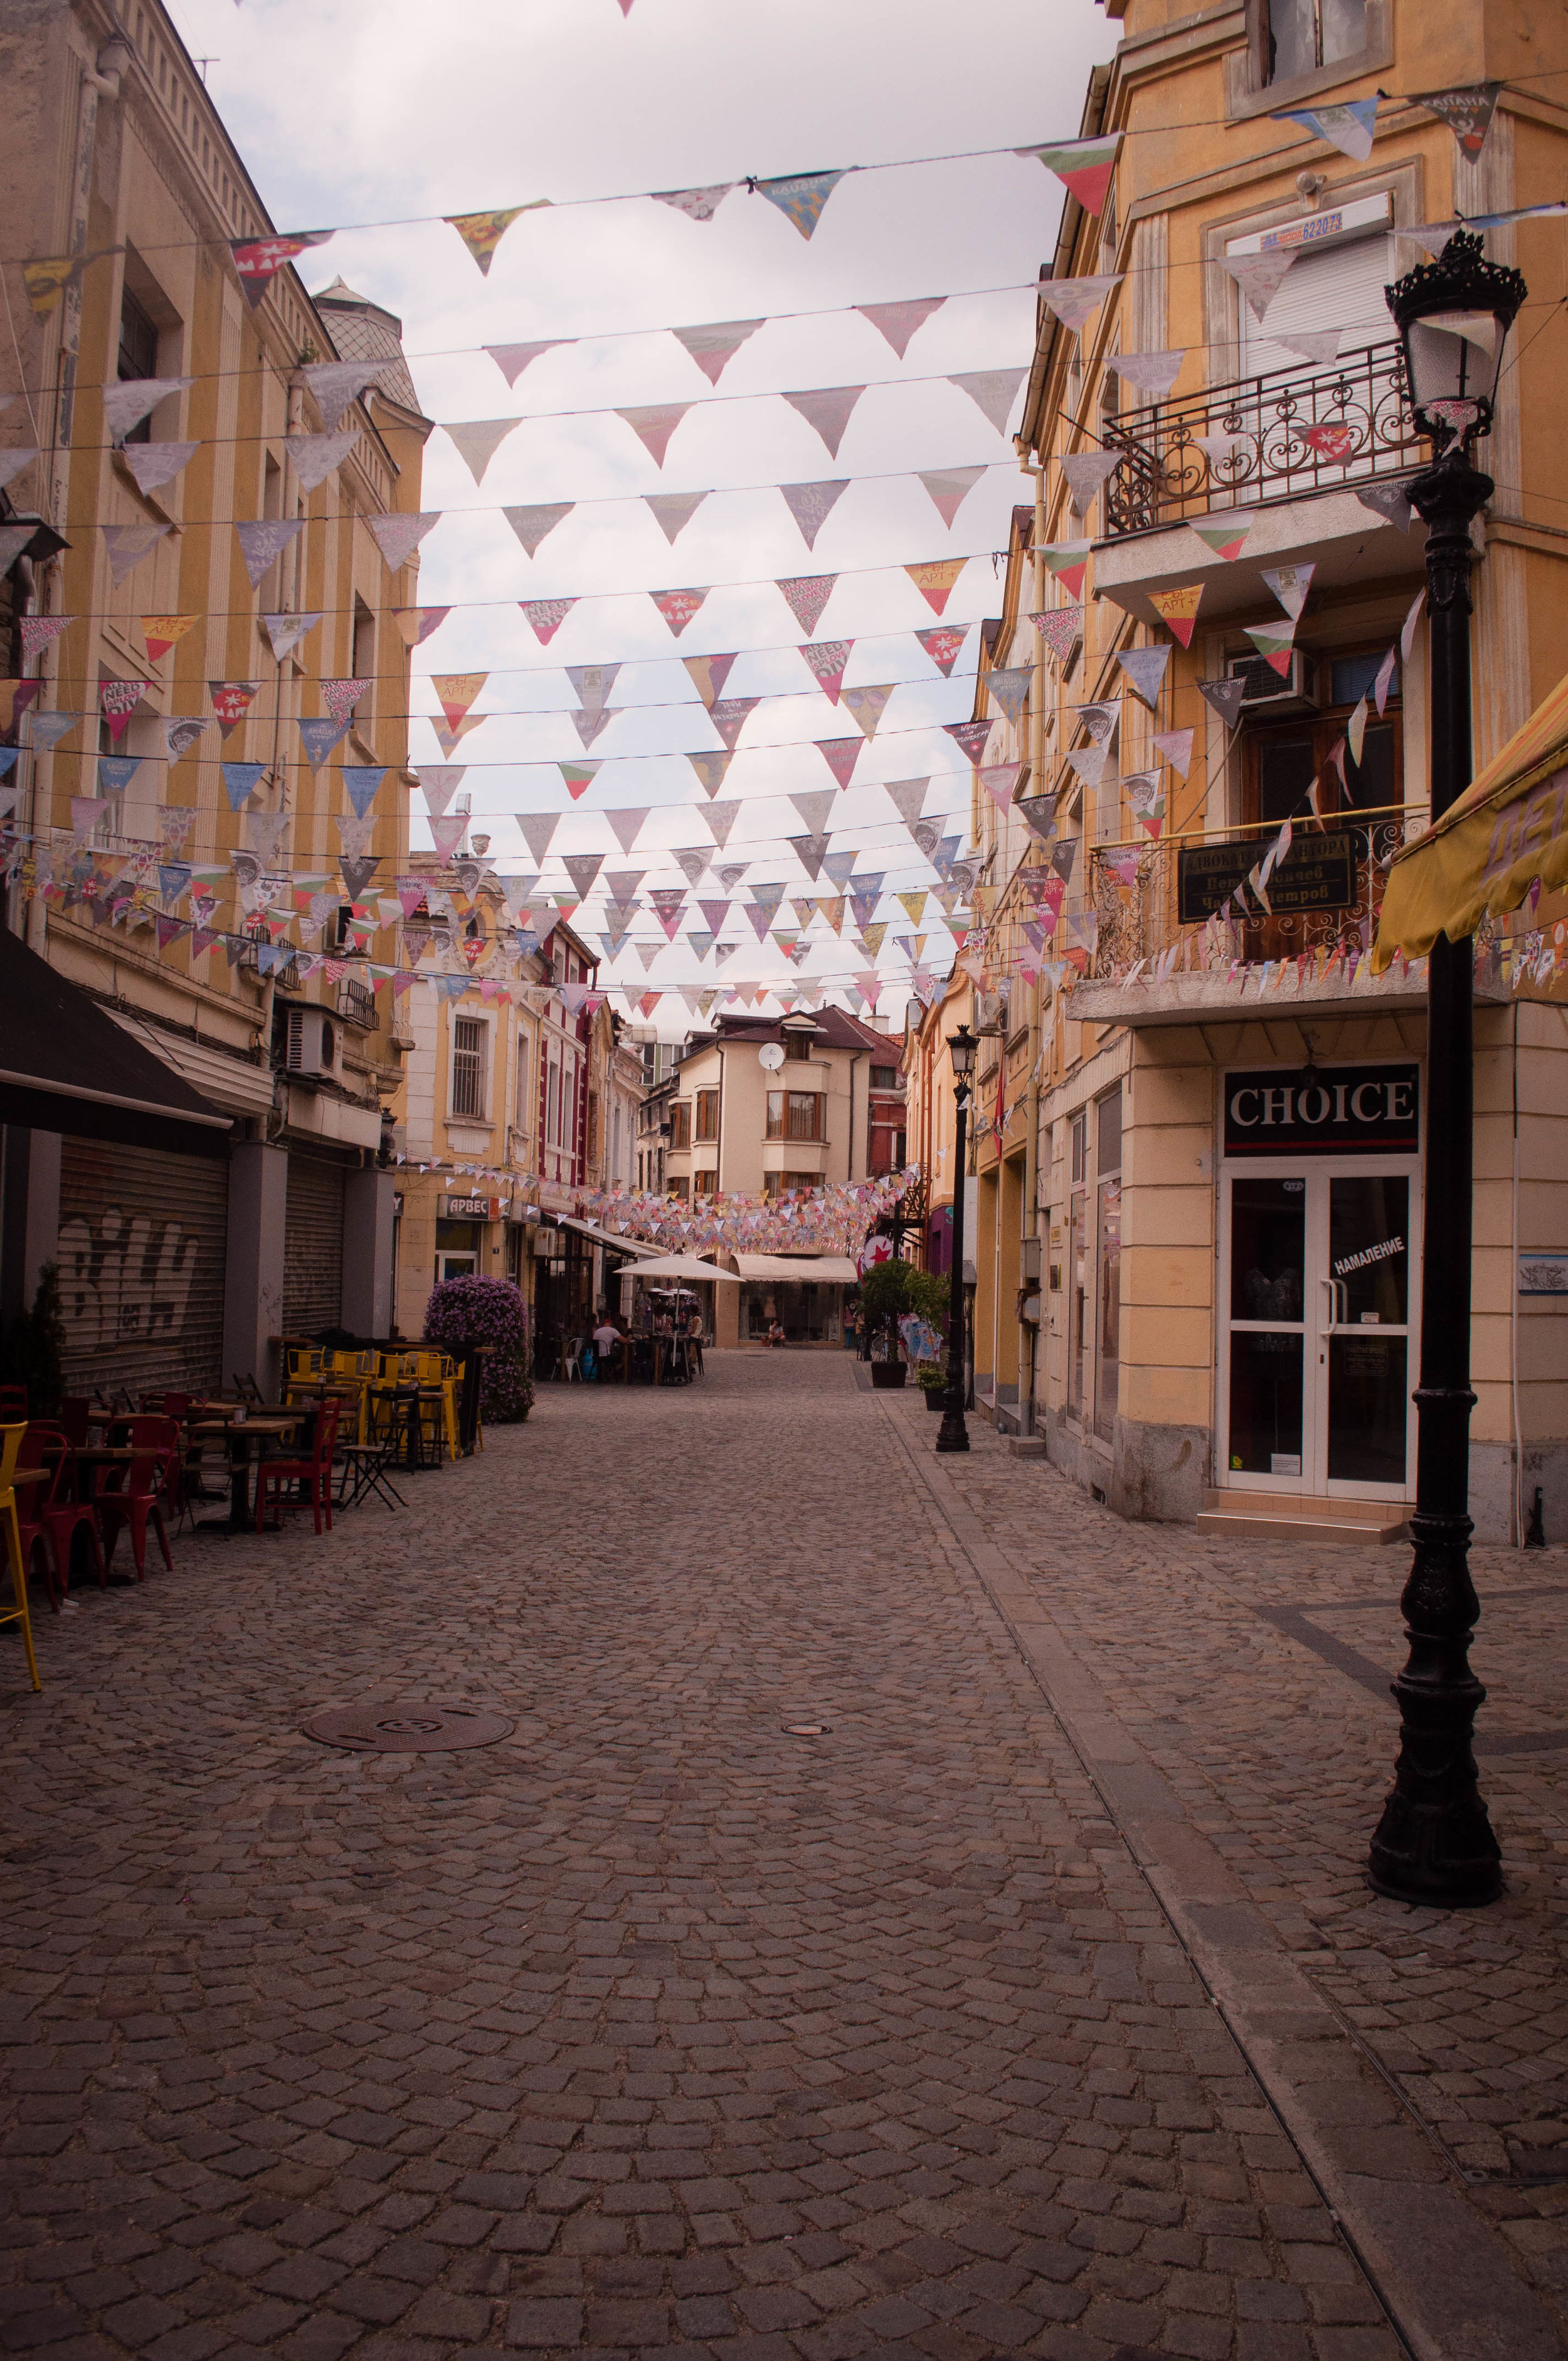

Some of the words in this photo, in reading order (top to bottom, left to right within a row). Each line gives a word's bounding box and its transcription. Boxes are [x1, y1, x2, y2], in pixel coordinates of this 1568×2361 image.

[105, 684, 140, 701] NEED
[1230, 1081, 1414, 1127] CHOICE
[450, 1199, 487, 1214] АРВЕС
[1334, 1236, 1406, 1275] НАМАЛЕНИЕ
